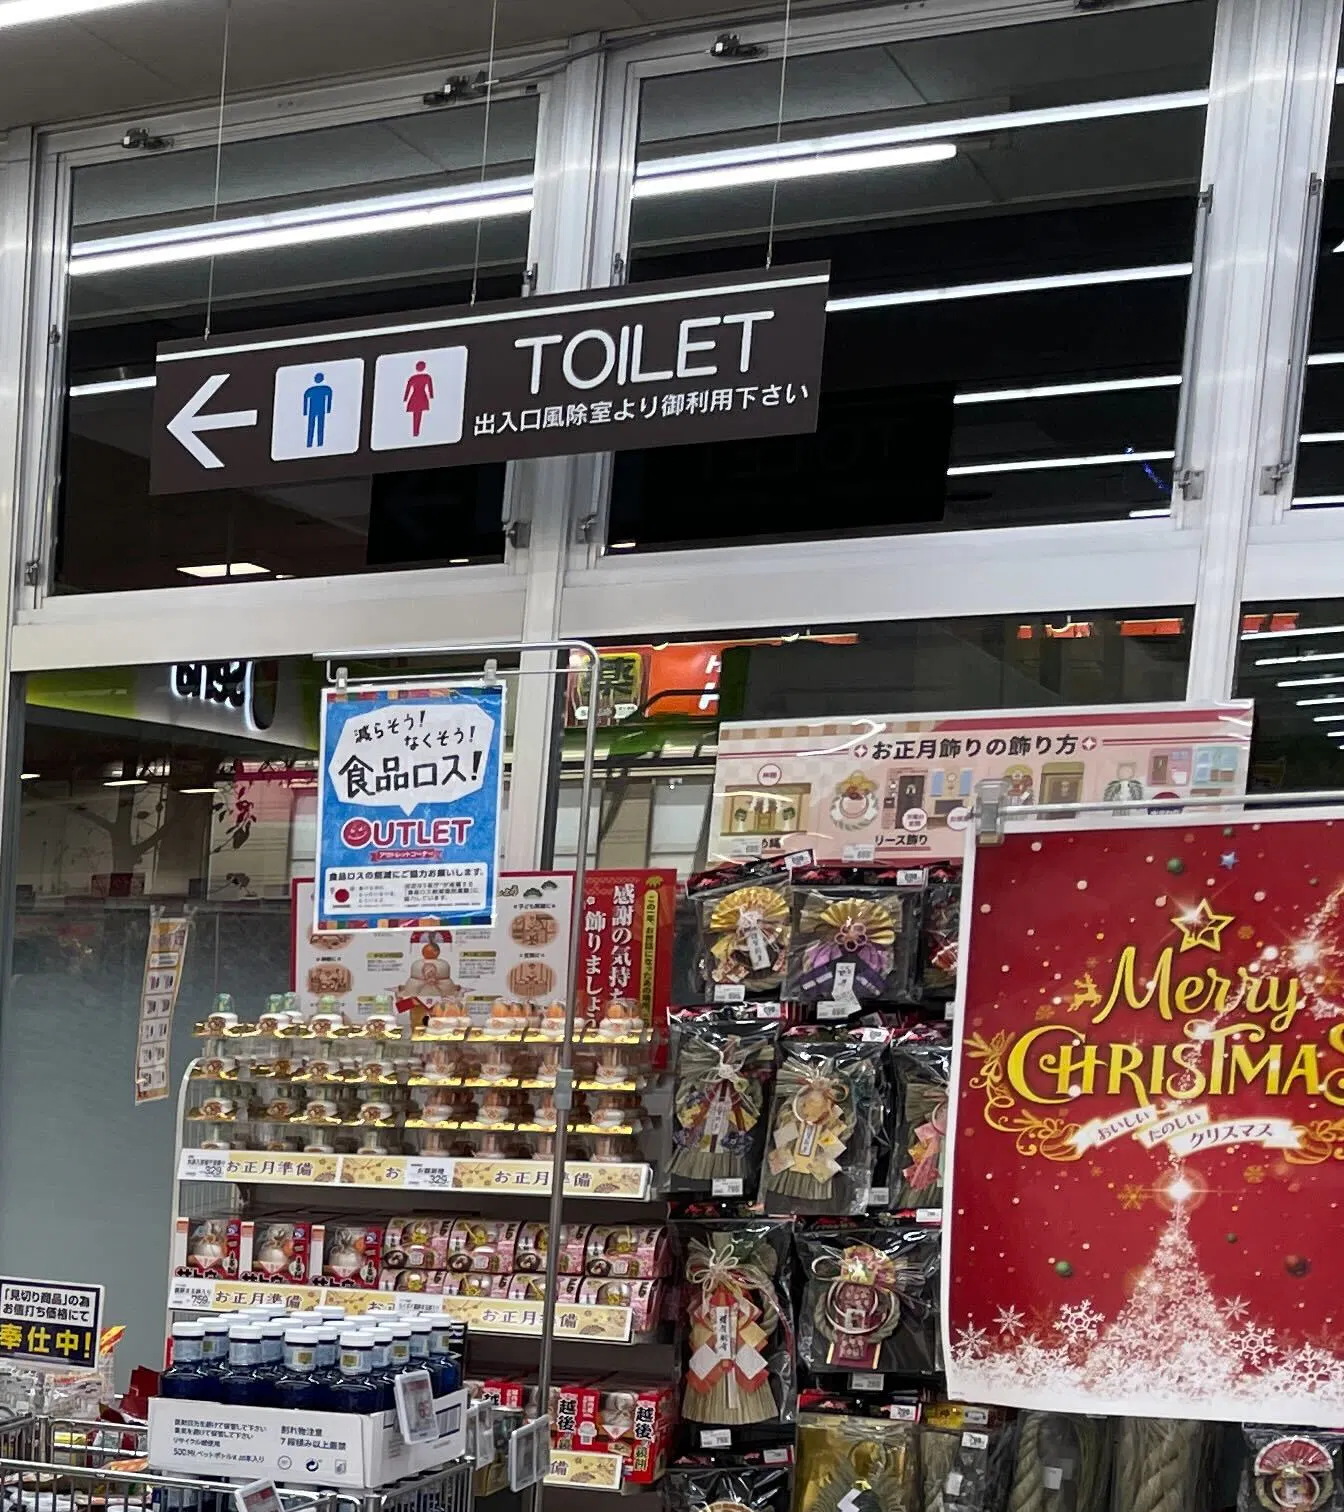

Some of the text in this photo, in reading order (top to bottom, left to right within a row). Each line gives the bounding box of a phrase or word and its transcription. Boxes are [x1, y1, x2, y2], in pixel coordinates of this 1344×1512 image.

[513, 310, 775, 395] TOILET
[473, 382, 809, 437] 出入口風除室より御利用下さい
[354, 710, 426, 744] 減らそう!
[404, 726, 476, 750] なくそう!
[871, 735, 1079, 760] お正月飾りの飾り方
[338, 751, 483, 798] 食品ロス!
[342, 817, 473, 848] OUTLET
[874, 834, 928, 847] リース飾り
[1094, 946, 1304, 1033] Merry
[1097, 1108, 1151, 1141] おいしい
[1148, 1111, 1202, 1143] たのしい
[1189, 1122, 1274, 1149] クリスマス
[227, 1159, 313, 1178] お正月準備
[2, 1303, 90, 1323] お値打ち価格にて
[4, 1287, 91, 1308] 「見切り商品」の為
[215, 1290, 303, 1309] お正月準備
[482, 1309, 578, 1330] お正月備
[557, 1397, 578, 1433] 越後
[634, 1403, 655, 1441] 越後
